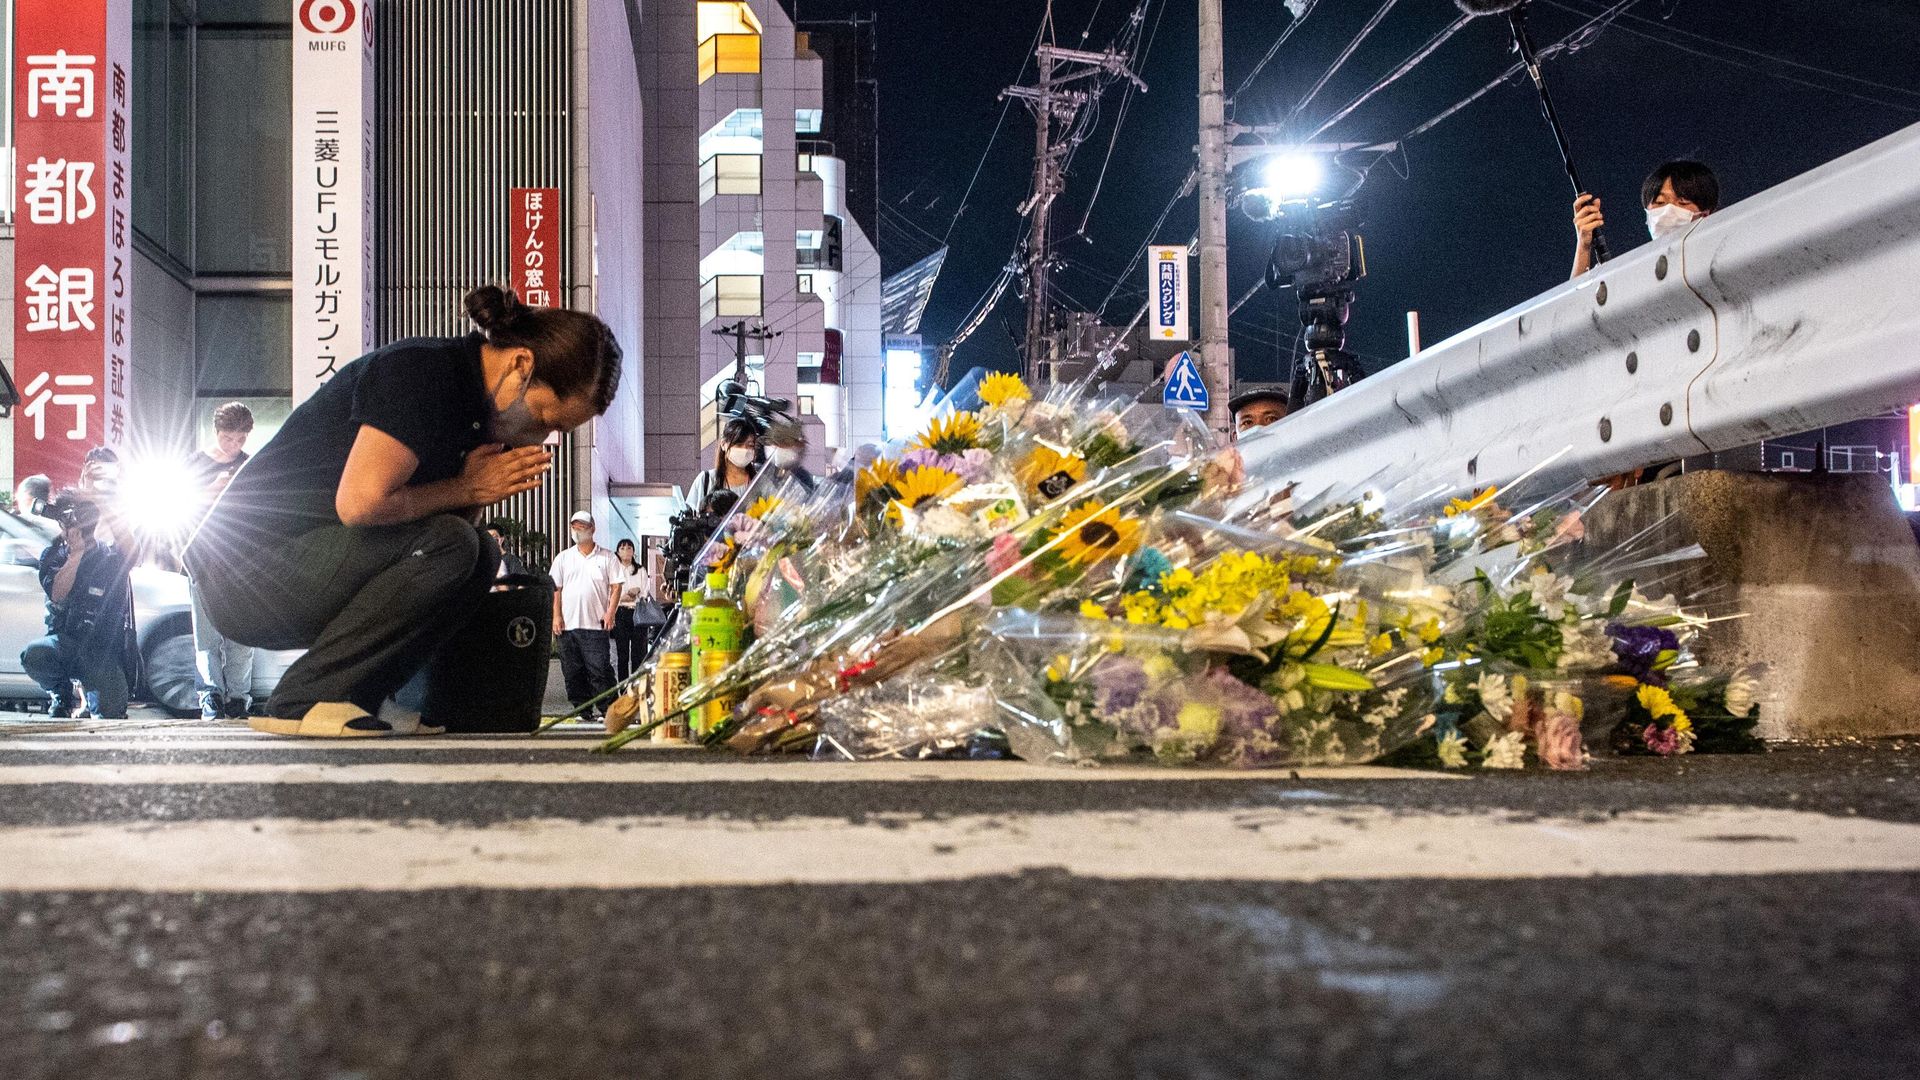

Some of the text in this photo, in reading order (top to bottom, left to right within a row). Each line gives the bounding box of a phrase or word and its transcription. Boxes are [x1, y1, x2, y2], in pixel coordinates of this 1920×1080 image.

[309, 41, 346, 51] MUFG
[24, 48, 97, 441] 南都銀行
[314, 111, 340, 387] 三菱UFJモルガン・ス
[525, 192, 544, 307] ほけんの窓口
